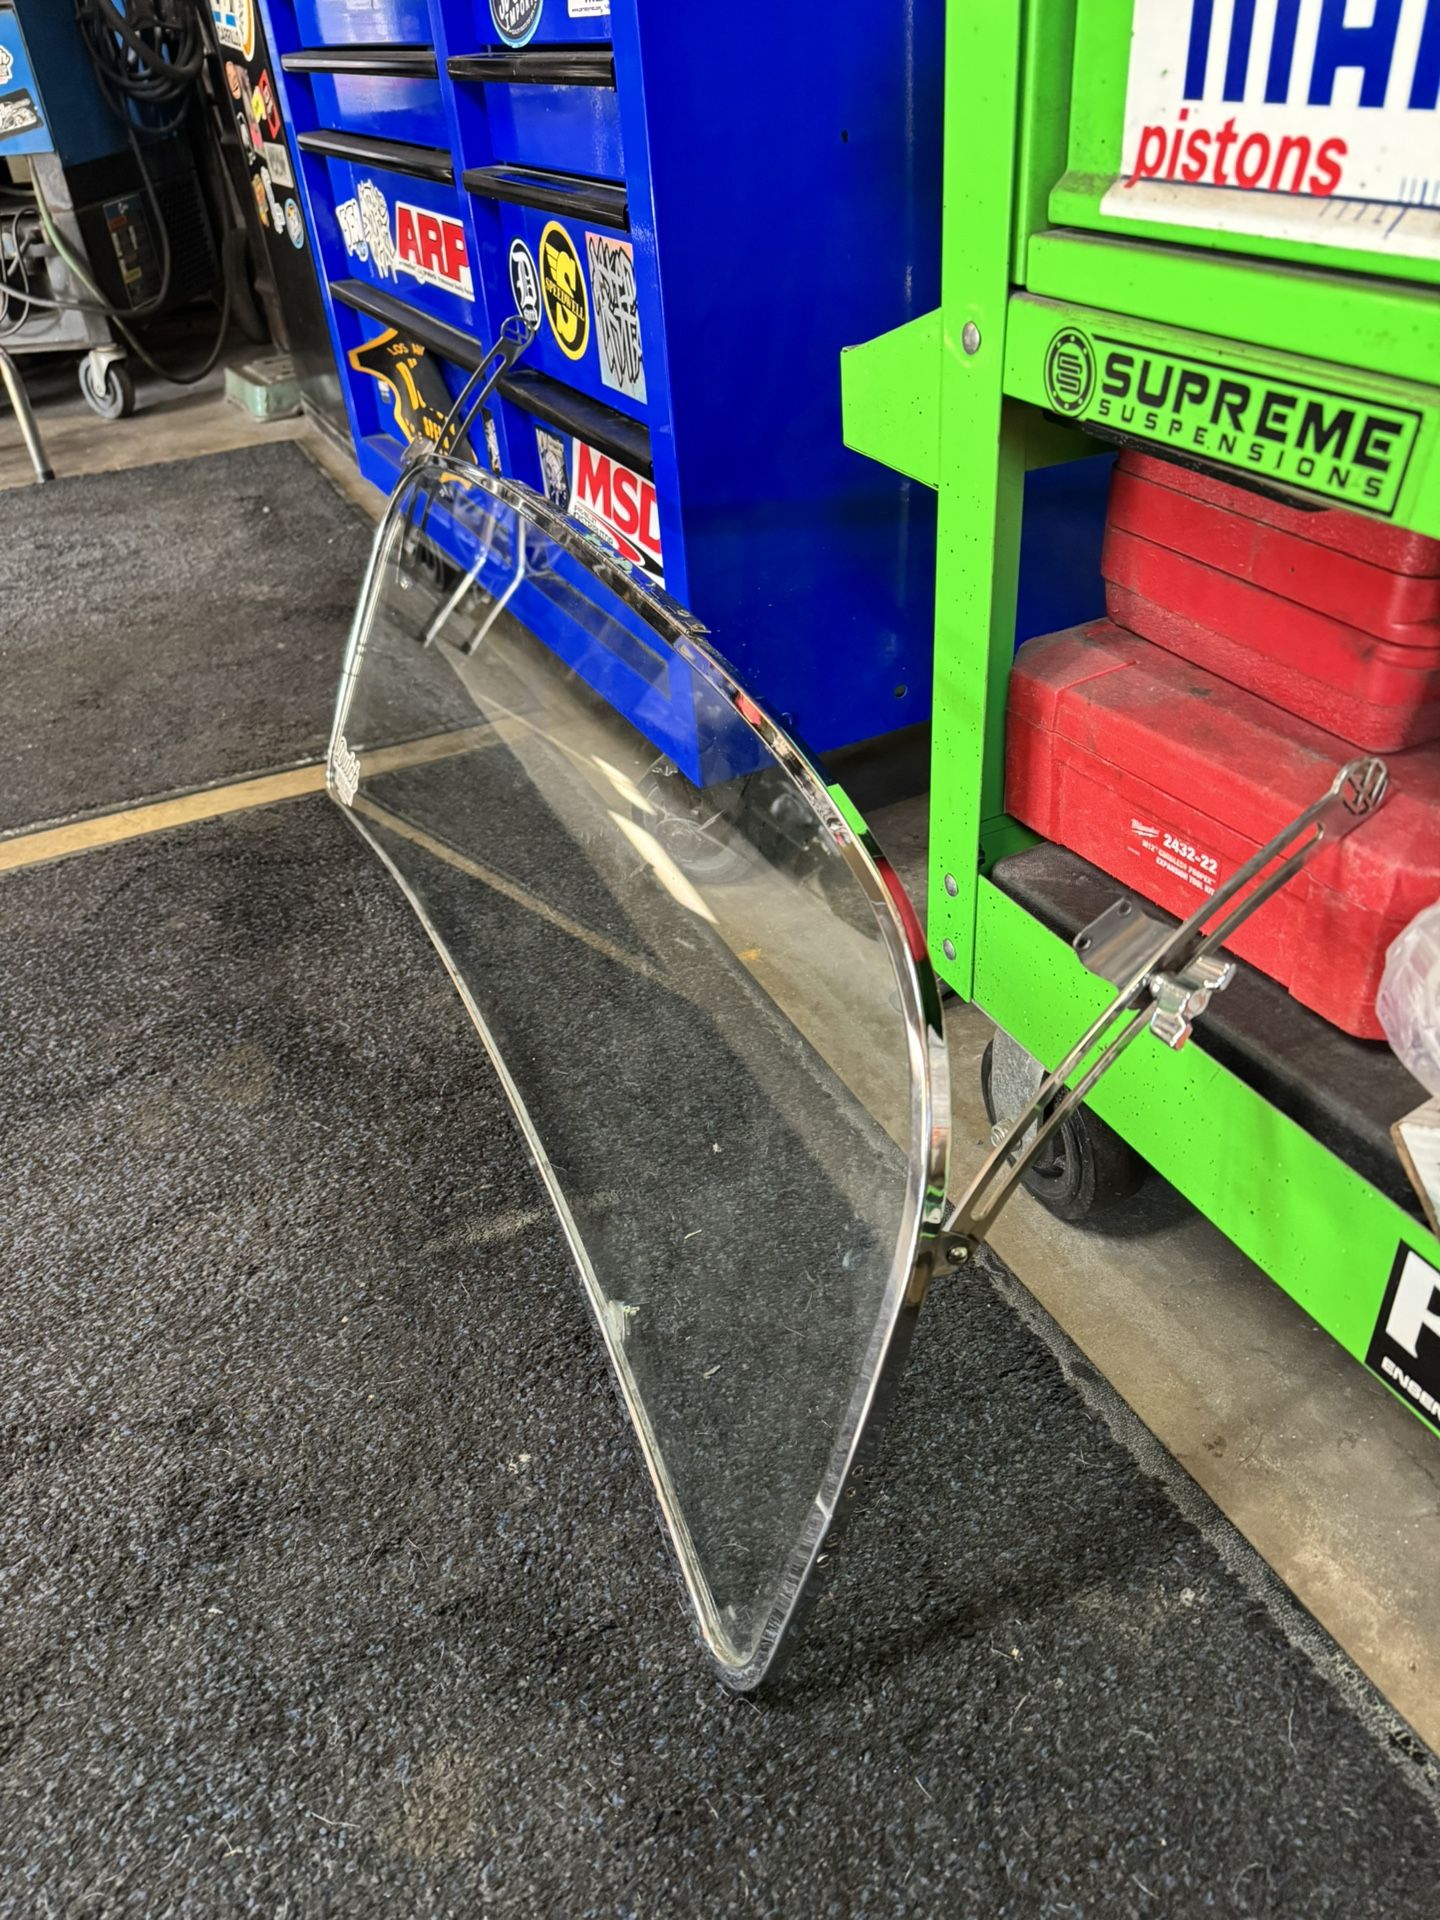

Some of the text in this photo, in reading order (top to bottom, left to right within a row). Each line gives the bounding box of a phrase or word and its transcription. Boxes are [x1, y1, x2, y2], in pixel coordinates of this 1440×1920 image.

[1124, 107, 1348, 197] pistons
[397, 206, 468, 283] ARP
[545, 276, 585, 321] SPEEDWELL
[1098, 400, 1384, 499] SUSPENSIONS
[1101, 351, 1404, 473] SUPREME
[577, 441, 662, 555] MSD
[1162, 832, 1218, 876] 2432-22
[1188, 875, 1204, 890] TOOL
